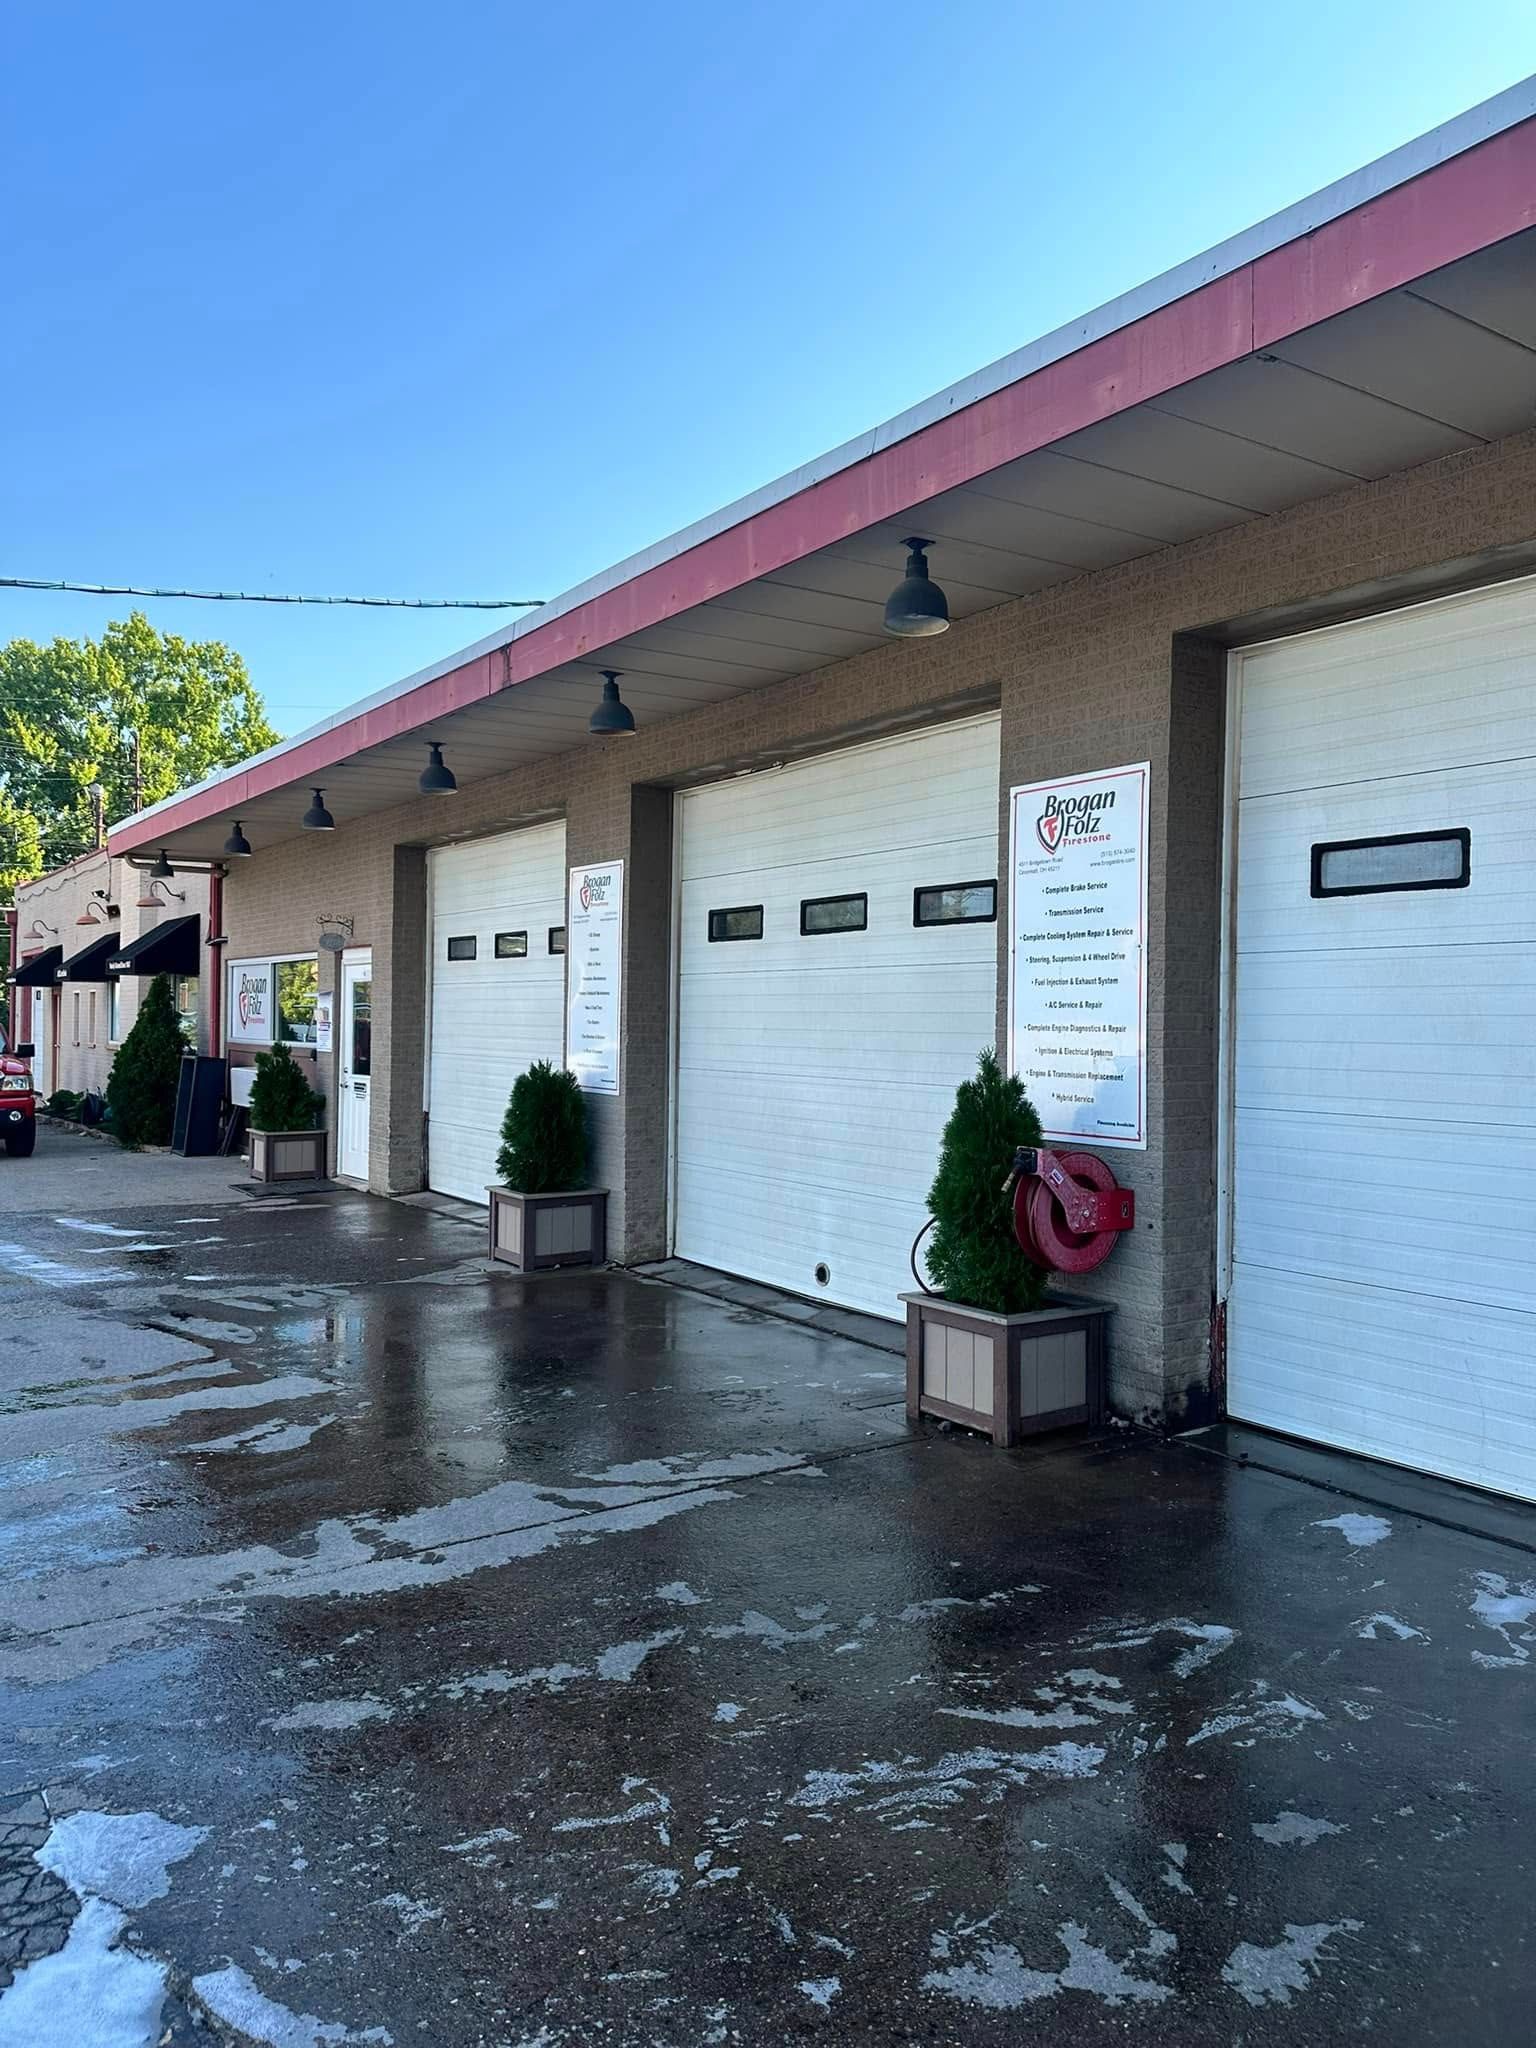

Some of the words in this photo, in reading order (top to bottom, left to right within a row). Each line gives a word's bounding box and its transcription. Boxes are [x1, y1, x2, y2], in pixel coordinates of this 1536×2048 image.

[1045, 791, 1115, 819] Brogan
[1064, 812, 1101, 836] Folz
[1062, 834, 1111, 847] Firestone
[583, 874, 612, 889] Brogan
[1045, 885, 1070, 895] Complete
[1070, 883, 1086, 892] Brake
[1087, 882, 1108, 891] Service
[1048, 908, 1083, 917] Transmission
[1083, 905, 1104, 914] Service
[1023, 933, 1046, 942] Complete
[1047, 932, 1066, 941] Cooling
[1066, 930, 1086, 940] System
[1087, 929, 1105, 939] Repair
[1112, 927, 1134, 937] Service
[1052, 954, 1081, 964] Suspension
[1093, 952, 1110, 961] Wheel
[1111, 952, 1126, 961] Drive
[1034, 978, 1046, 986] Fuel
[1046, 977, 1069, 987] Injection
[1075, 976, 1097, 985] Exhaust
[1098, 976, 1119, 986] System
[1058, 1000, 1079, 1009] Service
[1085, 1000, 1103, 1010] Repair
[1027, 1023, 1051, 1033] Complete
[1051, 1023, 1069, 1034] Engine
[1070, 1024, 1101, 1034] Diagnostics
[1108, 1024, 1127, 1034] Repair
[1038, 1046, 1058, 1056] Ignition
[1064, 1047, 1090, 1057] Electrical
[1090, 1048, 1114, 1058] Systems
[1029, 1068, 1047, 1079] Engine
[1052, 1069, 1087, 1080] Transmission
[1087, 1071, 1124, 1081] Replacement
[1056, 1093, 1073, 1103] Hybrid
[1074, 1095, 1095, 1103] Service
